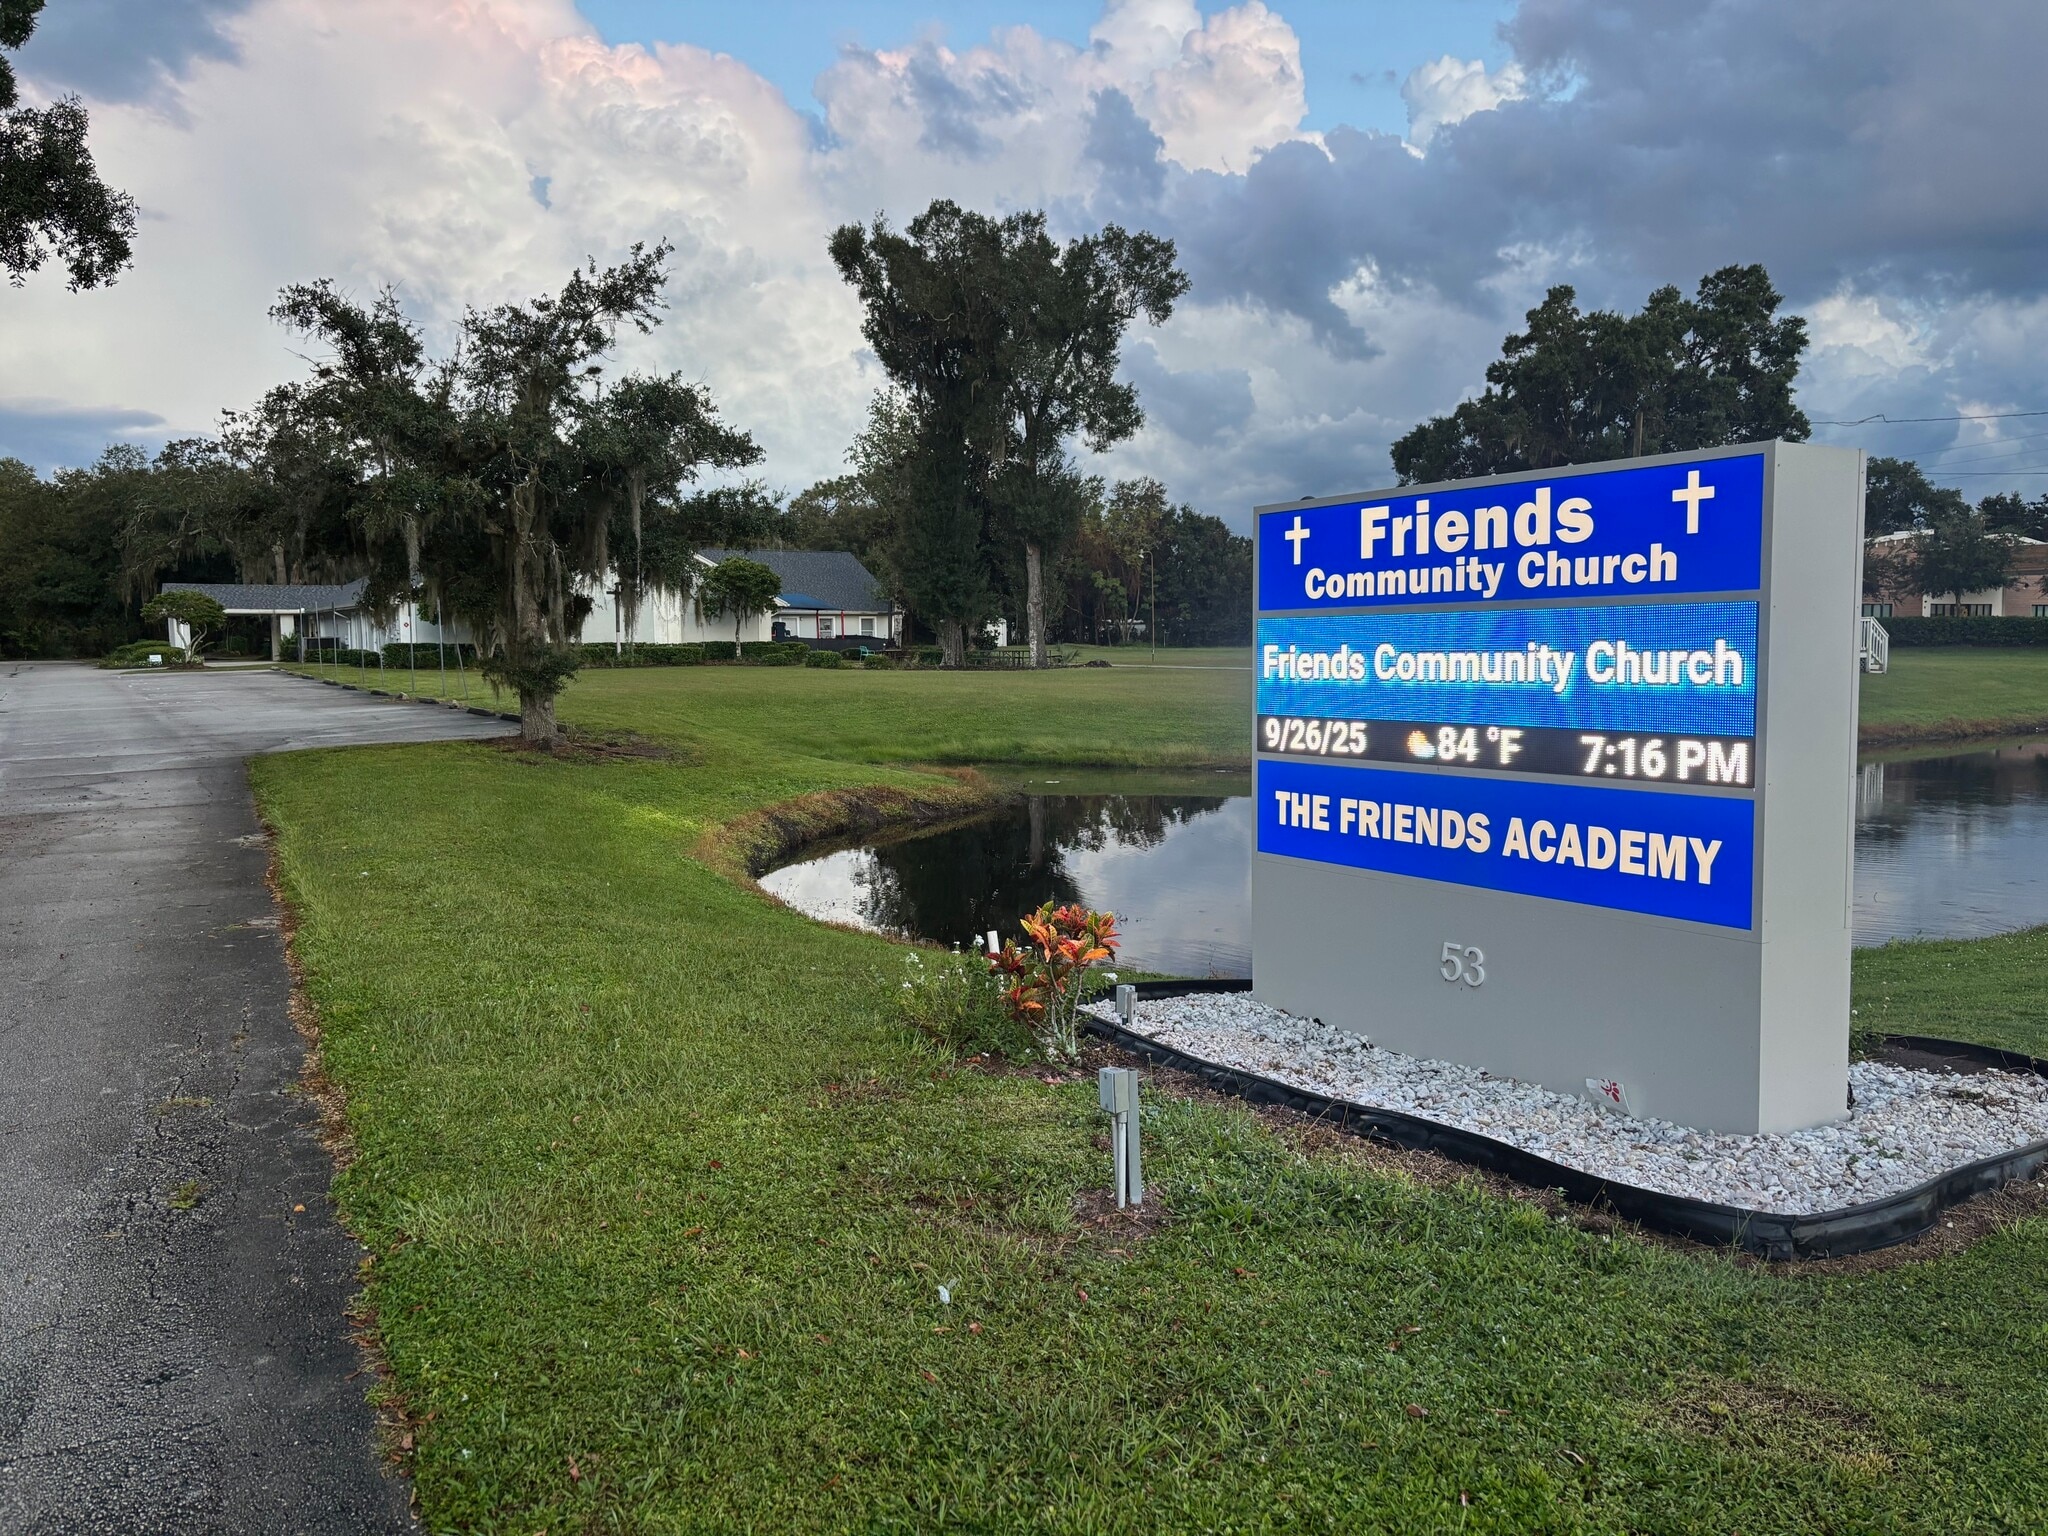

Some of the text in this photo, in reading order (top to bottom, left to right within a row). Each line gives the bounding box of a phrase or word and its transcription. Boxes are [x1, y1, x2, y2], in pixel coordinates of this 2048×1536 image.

[1360, 487, 1594, 559] Friends
[1305, 543, 1677, 599] Community Church
[1263, 639, 1743, 692] Friends Community Church
[1265, 717, 1367, 754] 9/26/25
[1437, 726, 1478, 762] 84
[1581, 735, 1666, 777] 7:16
[1677, 740, 1748, 784] PM
[1275, 791, 1722, 885] THE FRIENDS ACADEMY
[1440, 942, 1485, 987] 53
